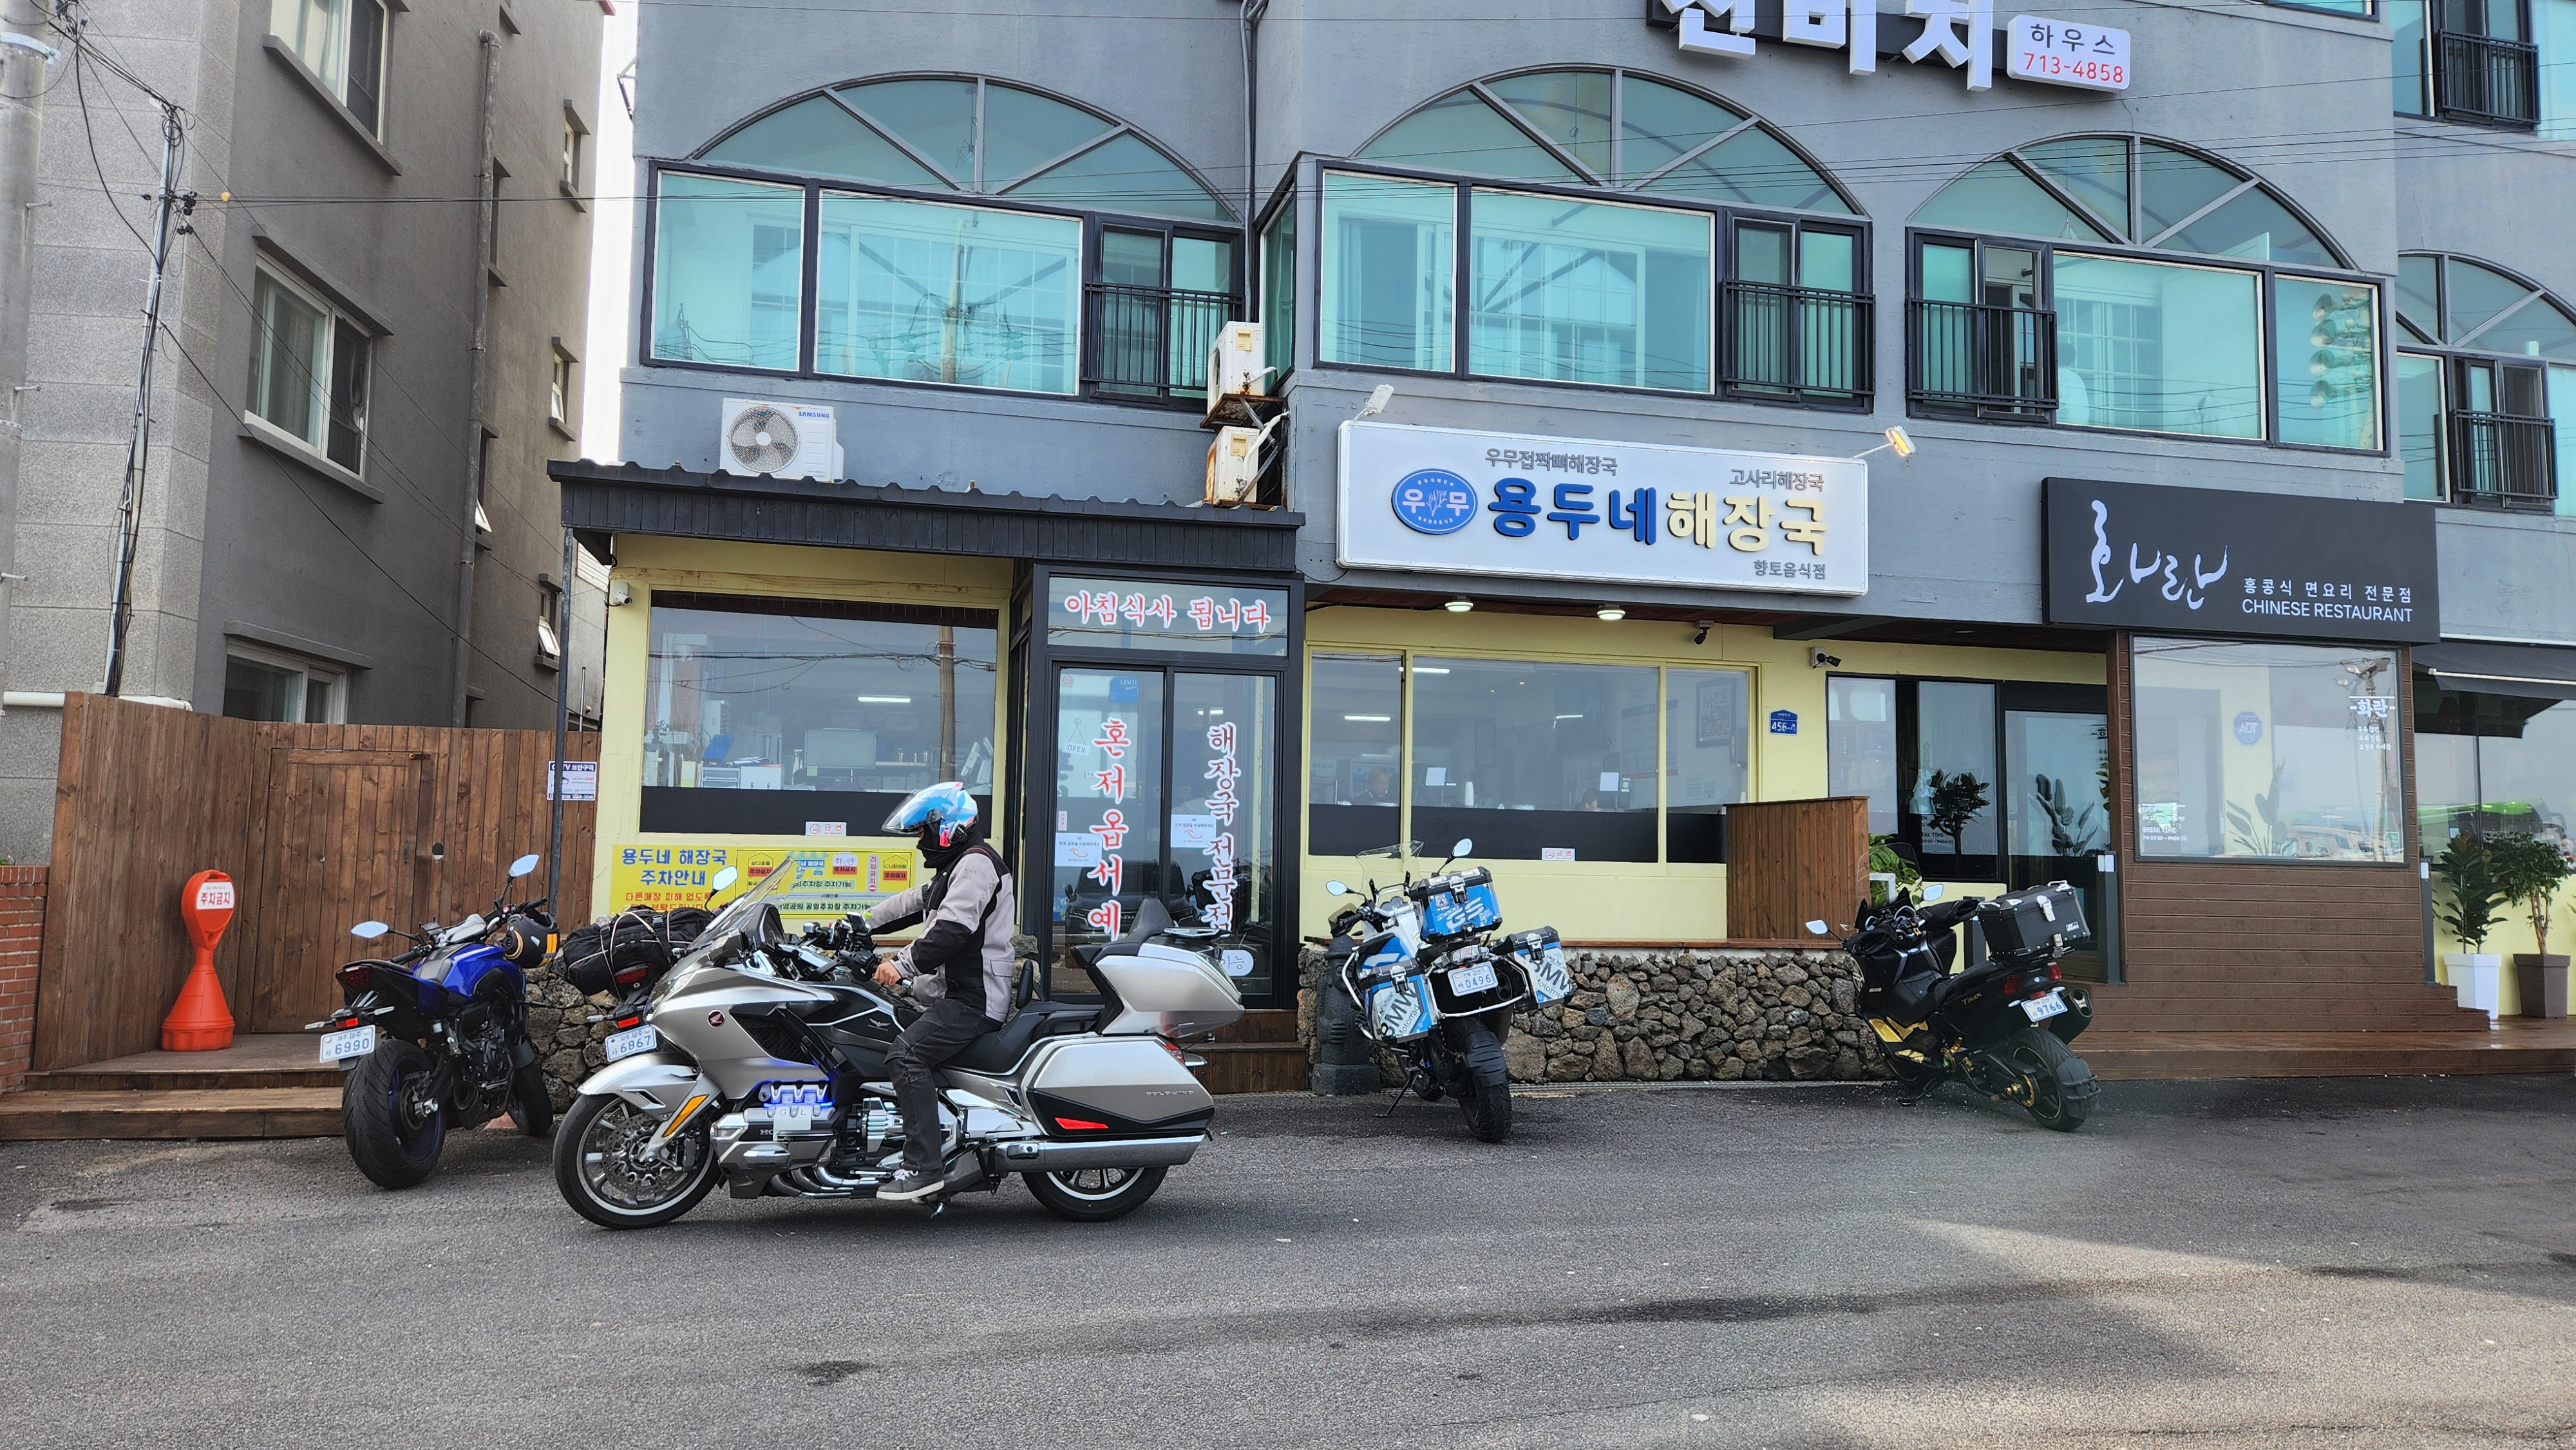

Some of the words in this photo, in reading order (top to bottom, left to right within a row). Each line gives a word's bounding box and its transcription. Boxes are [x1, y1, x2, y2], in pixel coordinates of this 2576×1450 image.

[2030, 23, 2116, 55] 하우스
[2024, 52, 2124, 84] 713-4858
[1485, 447, 1618, 476] 우무접짝뼈해장국
[1729, 469, 1825, 493] 고사리해장국
[1754, 559, 1826, 580] 향토음식점
[2243, 578, 2292, 596] 홍콩식
[2305, 581, 2353, 600] 면요리
[2364, 585, 2411, 603] 전문점
[1065, 590, 1177, 628] 아침식사
[1187, 596, 1271, 633] 됩니다
[2242, 598, 2311, 617] CHINESE
[2314, 603, 2414, 623] RESTAURANT
[2357, 699, 2389, 717] 화란
[2238, 721, 2259, 734] ADT
[1067, 744, 1086, 753] OPEN
[1204, 721, 1242, 826] 해장국
[622, 848, 671, 865] 용두네
[679, 849, 728, 866] 해장국
[640, 870, 706, 886] 주차안내
[201, 892, 231, 907] 주차금지
[625, 892, 661, 902] 다른매장
[665, 892, 683, 902] 피해
[1465, 974, 1492, 988] 0496
[1961, 992, 1982, 1005] TMAX
[2037, 1001, 2062, 1015] 9766
[1396, 1004, 1420, 1037] Motorrad
[335, 1038, 370, 1055] 6990
[620, 1035, 651, 1053] 6867
